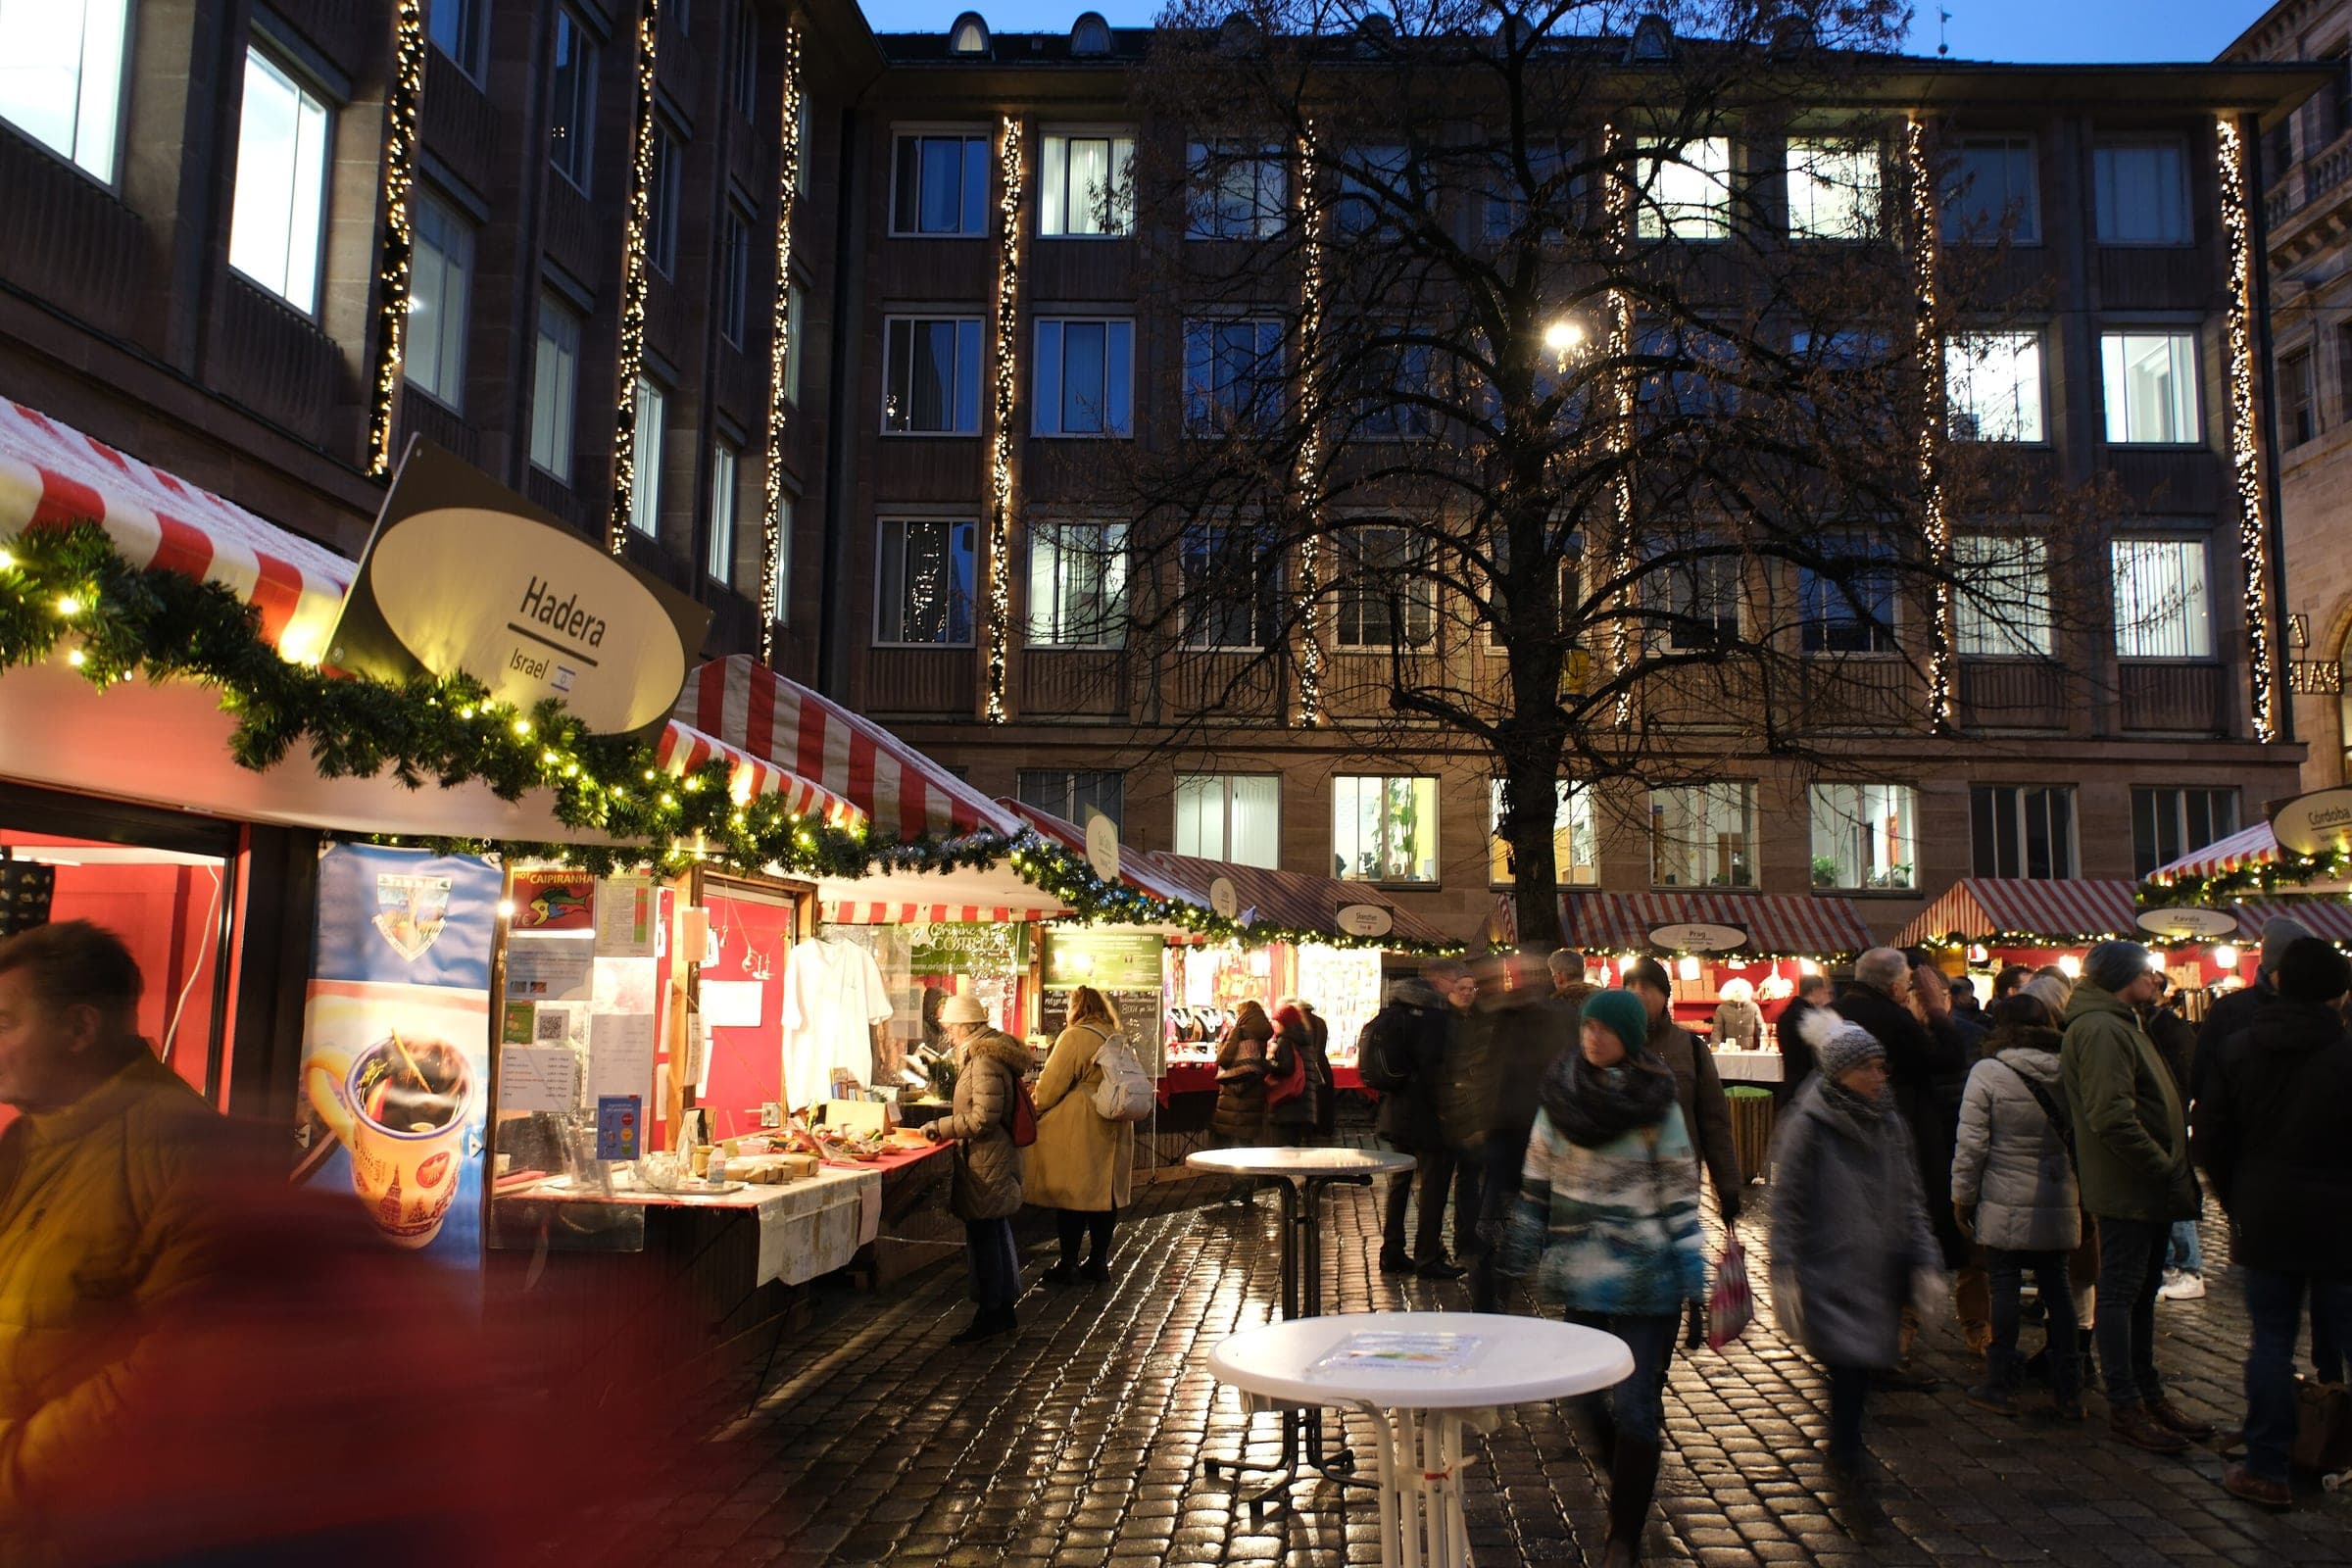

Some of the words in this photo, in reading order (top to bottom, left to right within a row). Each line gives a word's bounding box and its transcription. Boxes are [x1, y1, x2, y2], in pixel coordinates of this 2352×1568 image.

[520, 575, 606, 648] Hadera
[510, 648, 549, 680] Israel
[514, 871, 530, 880] HOT
[530, 873, 595, 885] CAIPIRANHA
[1690, 930, 1706, 939] Prag
